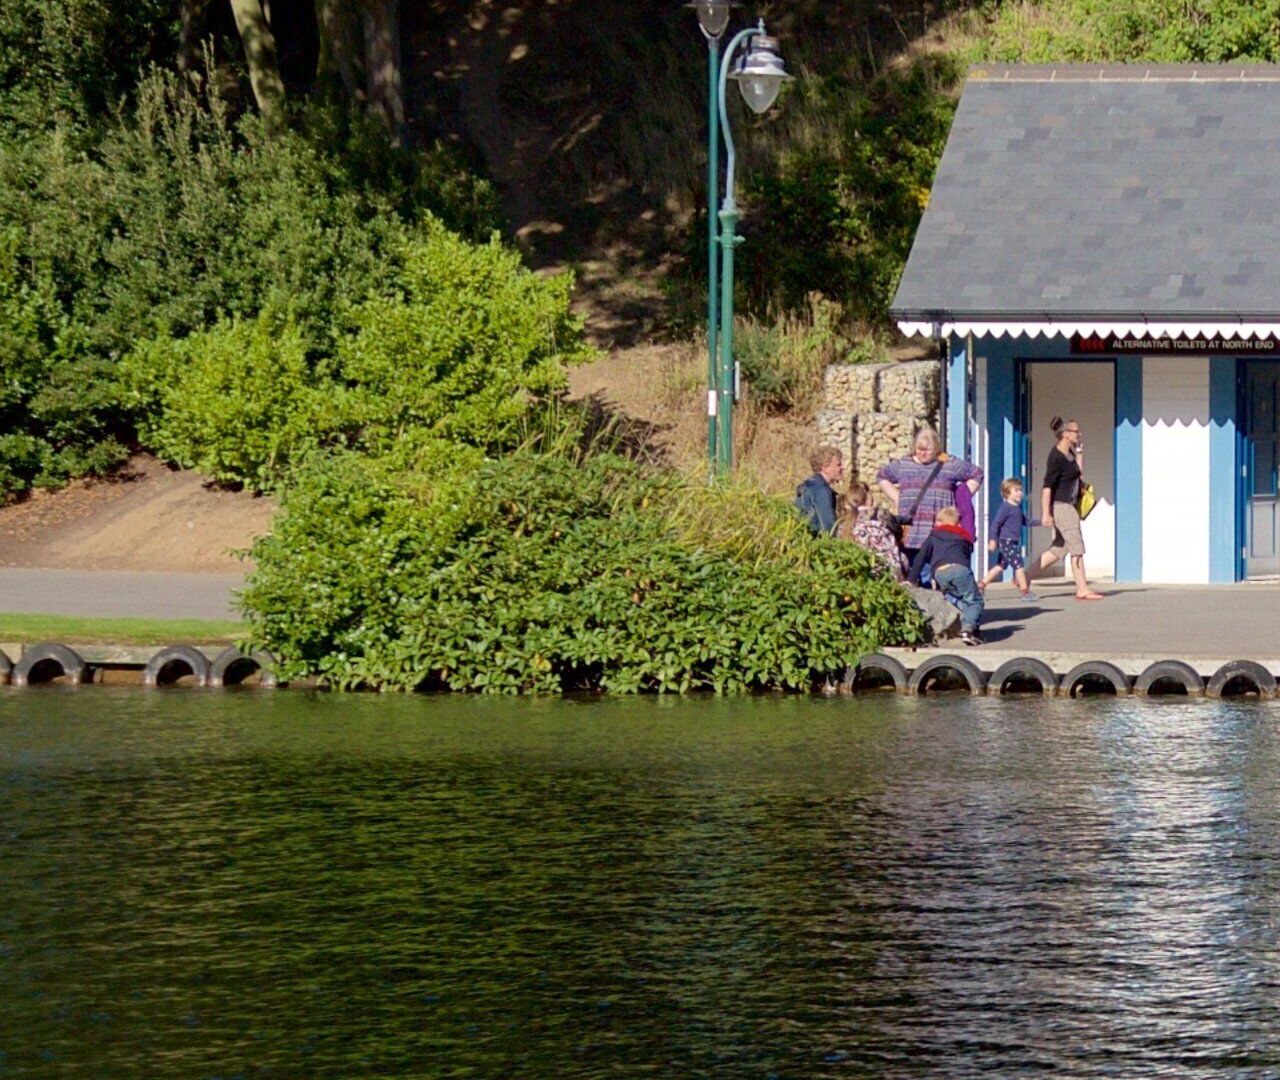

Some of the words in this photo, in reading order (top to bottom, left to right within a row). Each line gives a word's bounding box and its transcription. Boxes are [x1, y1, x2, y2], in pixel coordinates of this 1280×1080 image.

[1112, 340, 1170, 349] ALTERNATIVE
[1172, 340, 1206, 349] TOILETS
[1208, 340, 1219, 349] AT
[1222, 340, 1252, 349] NORTH
[1255, 340, 1275, 350] END
